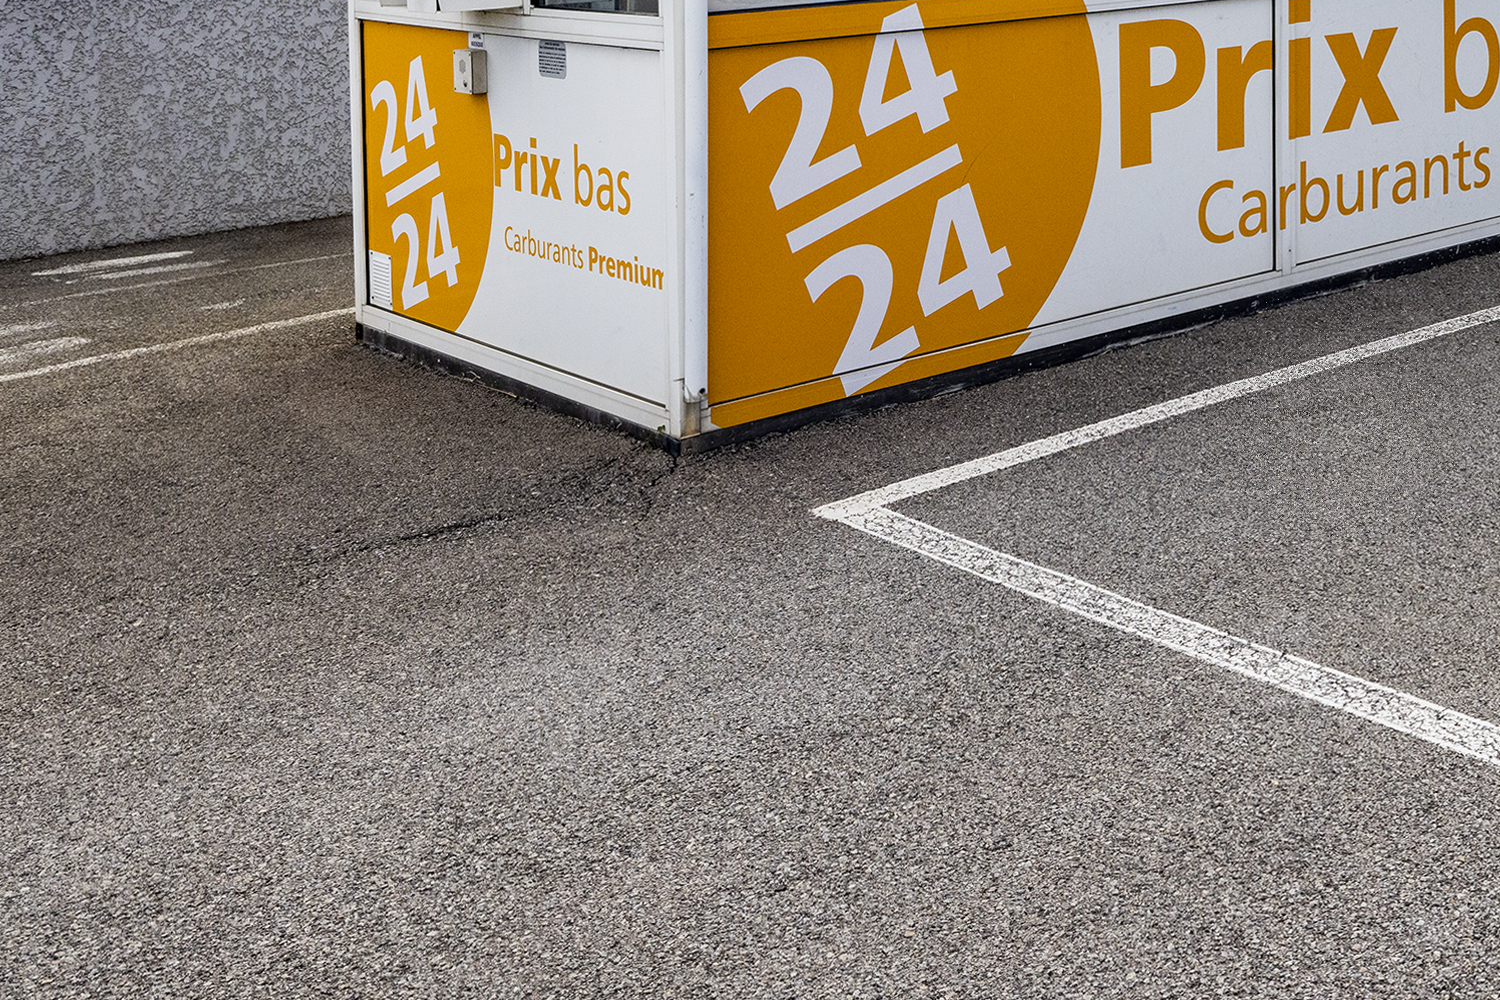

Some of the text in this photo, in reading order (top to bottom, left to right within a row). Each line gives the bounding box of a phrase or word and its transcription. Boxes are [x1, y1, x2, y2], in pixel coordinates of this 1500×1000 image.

[370, 55, 438, 177] 24
[739, 3, 957, 210] 24
[494, 134, 631, 216] Prix bas
[1199, 141, 1490, 243] Carburants
[391, 192, 460, 311] 24
[504, 226, 584, 269] Carburants
[805, 183, 1012, 397] 24
